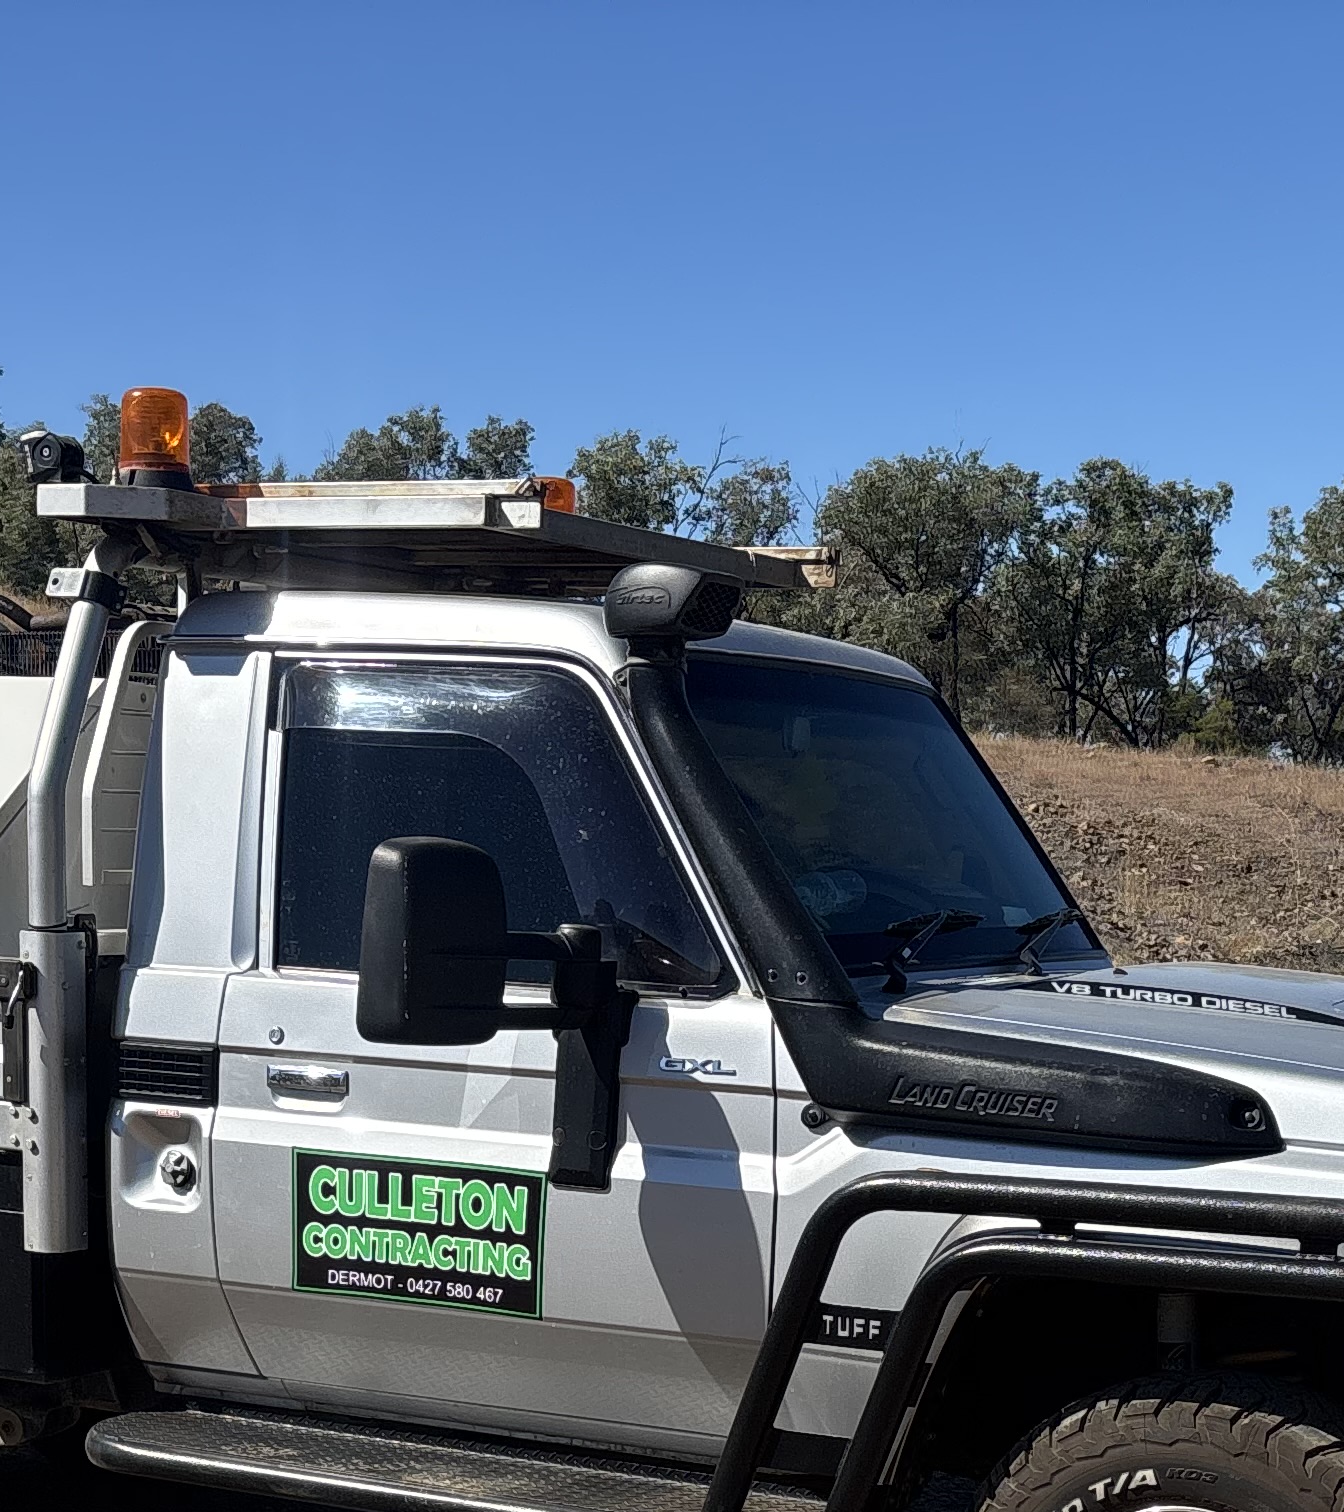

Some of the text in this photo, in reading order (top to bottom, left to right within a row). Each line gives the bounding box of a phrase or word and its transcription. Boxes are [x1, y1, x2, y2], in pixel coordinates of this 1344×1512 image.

[1050, 981, 1297, 1020] V8 TURBO DIESEL
[659, 1056, 737, 1076] GXL
[888, 1075, 1058, 1122] LAND CRUISER
[308, 1164, 529, 1235] CULLETON
[302, 1221, 532, 1281] CONTRACTING
[327, 1269, 395, 1290] DERMOT
[406, 1277, 442, 1296] 0427
[445, 1281, 473, 1300] 580
[475, 1286, 504, 1304] 467
[821, 1314, 882, 1340] TUFF
[1088, 1468, 1158, 1502] T/A
